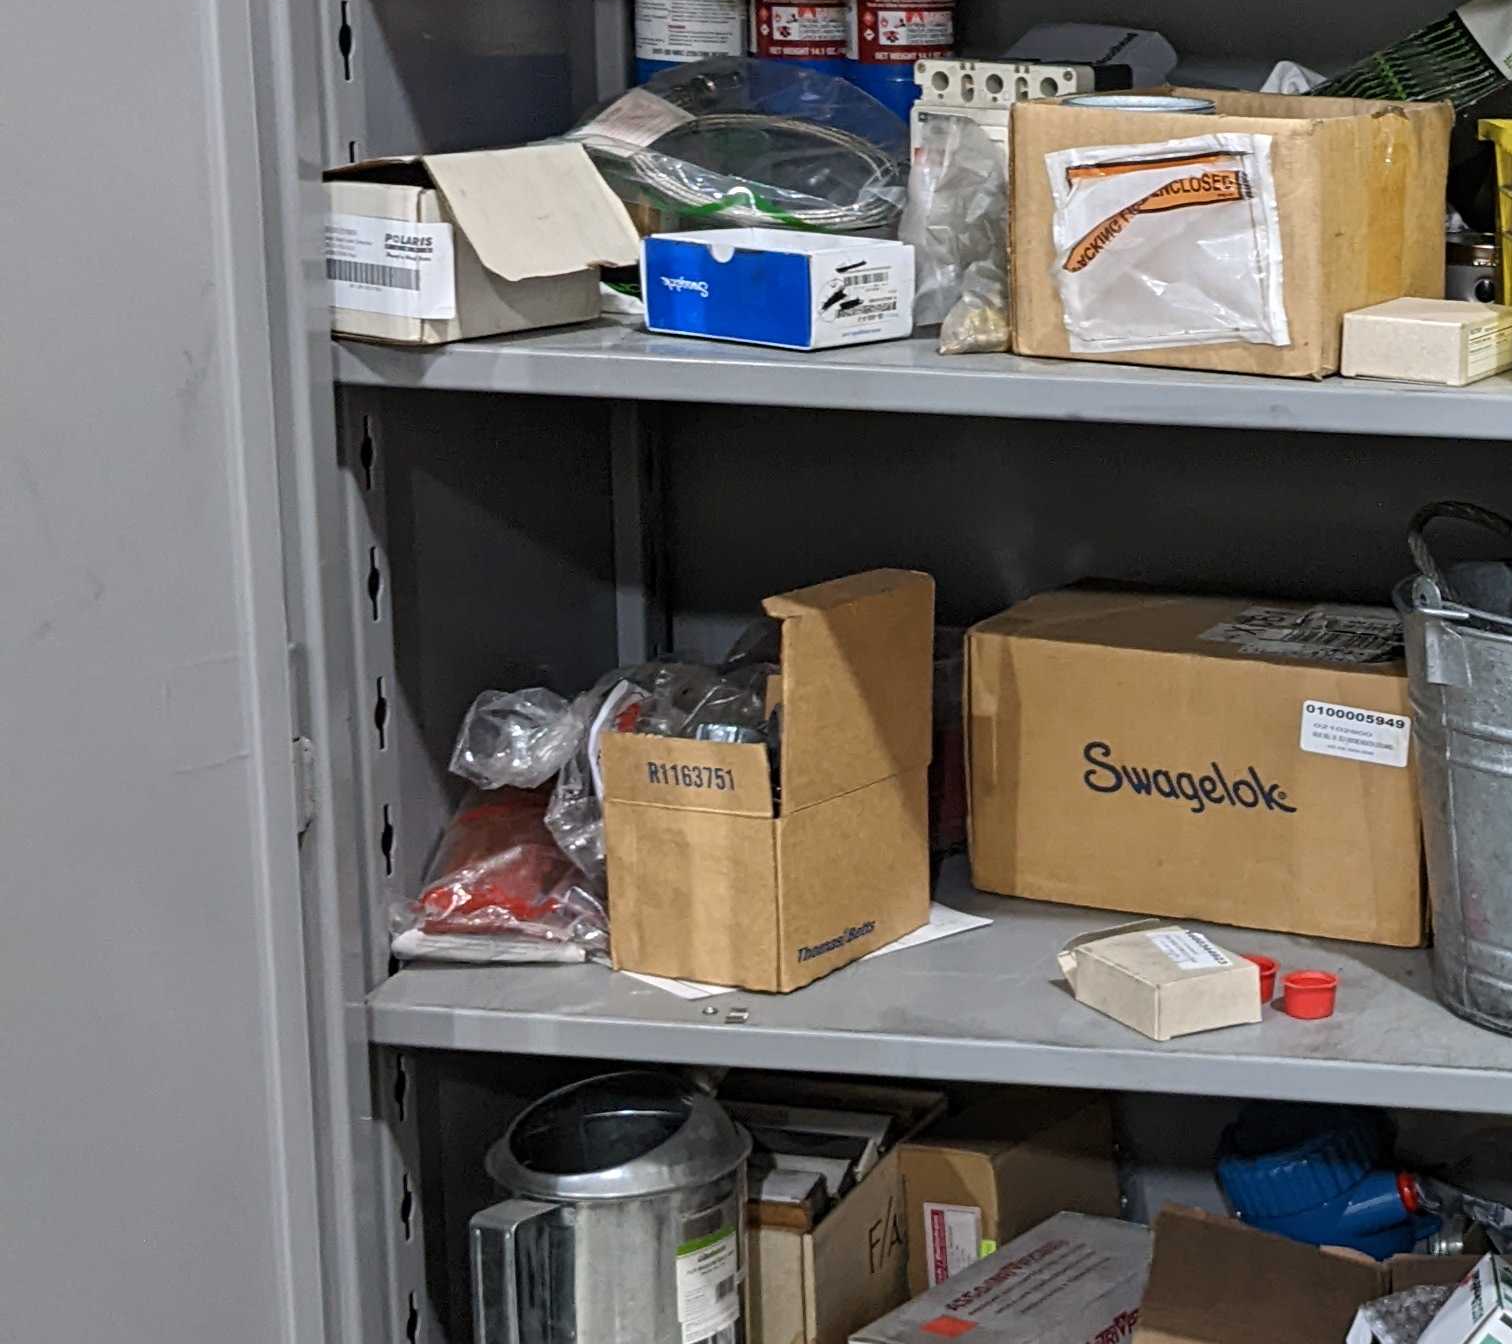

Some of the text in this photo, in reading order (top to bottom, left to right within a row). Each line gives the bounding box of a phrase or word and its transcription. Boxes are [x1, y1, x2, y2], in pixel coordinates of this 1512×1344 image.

[1306, 704, 1405, 729] 0100005949
[648, 761, 735, 791] R1163751
[1084, 741, 1297, 813] Swagelok
